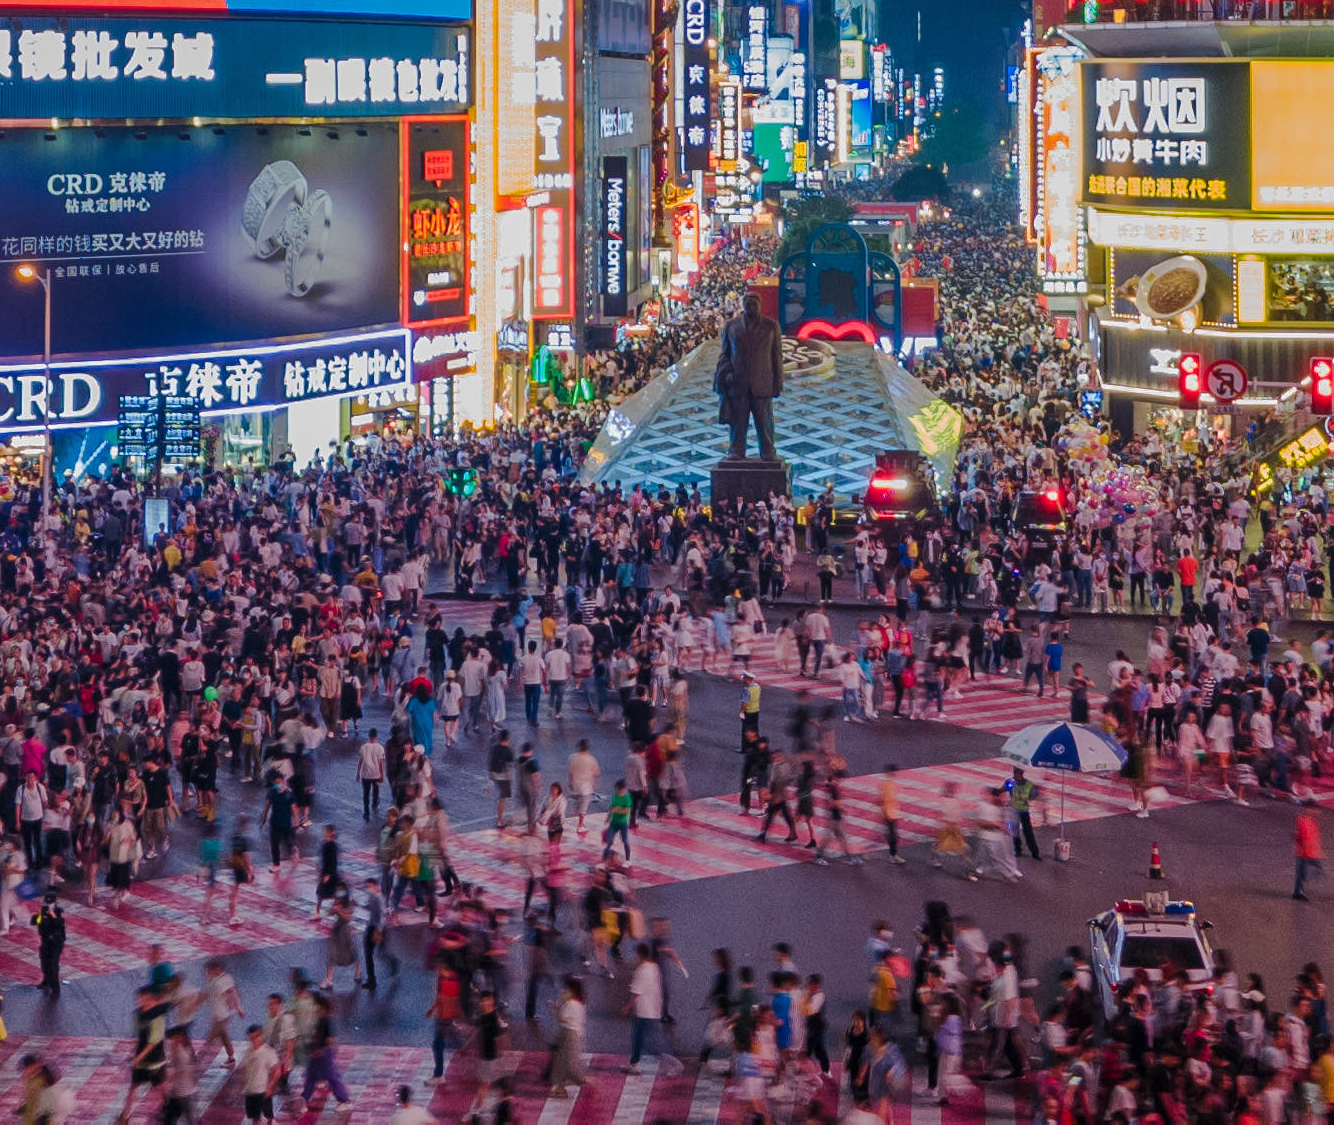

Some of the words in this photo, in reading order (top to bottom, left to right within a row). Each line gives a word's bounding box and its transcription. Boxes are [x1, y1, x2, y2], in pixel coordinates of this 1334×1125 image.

[1096, 77, 1206, 134] 炊烟
[1096, 138, 1207, 166] 小炒黄牛肉
[47, 174, 103, 195] CRD
[65, 197, 151, 214] 钻戒定制中心
[284, 349, 405, 398] 钻戒定制中心
